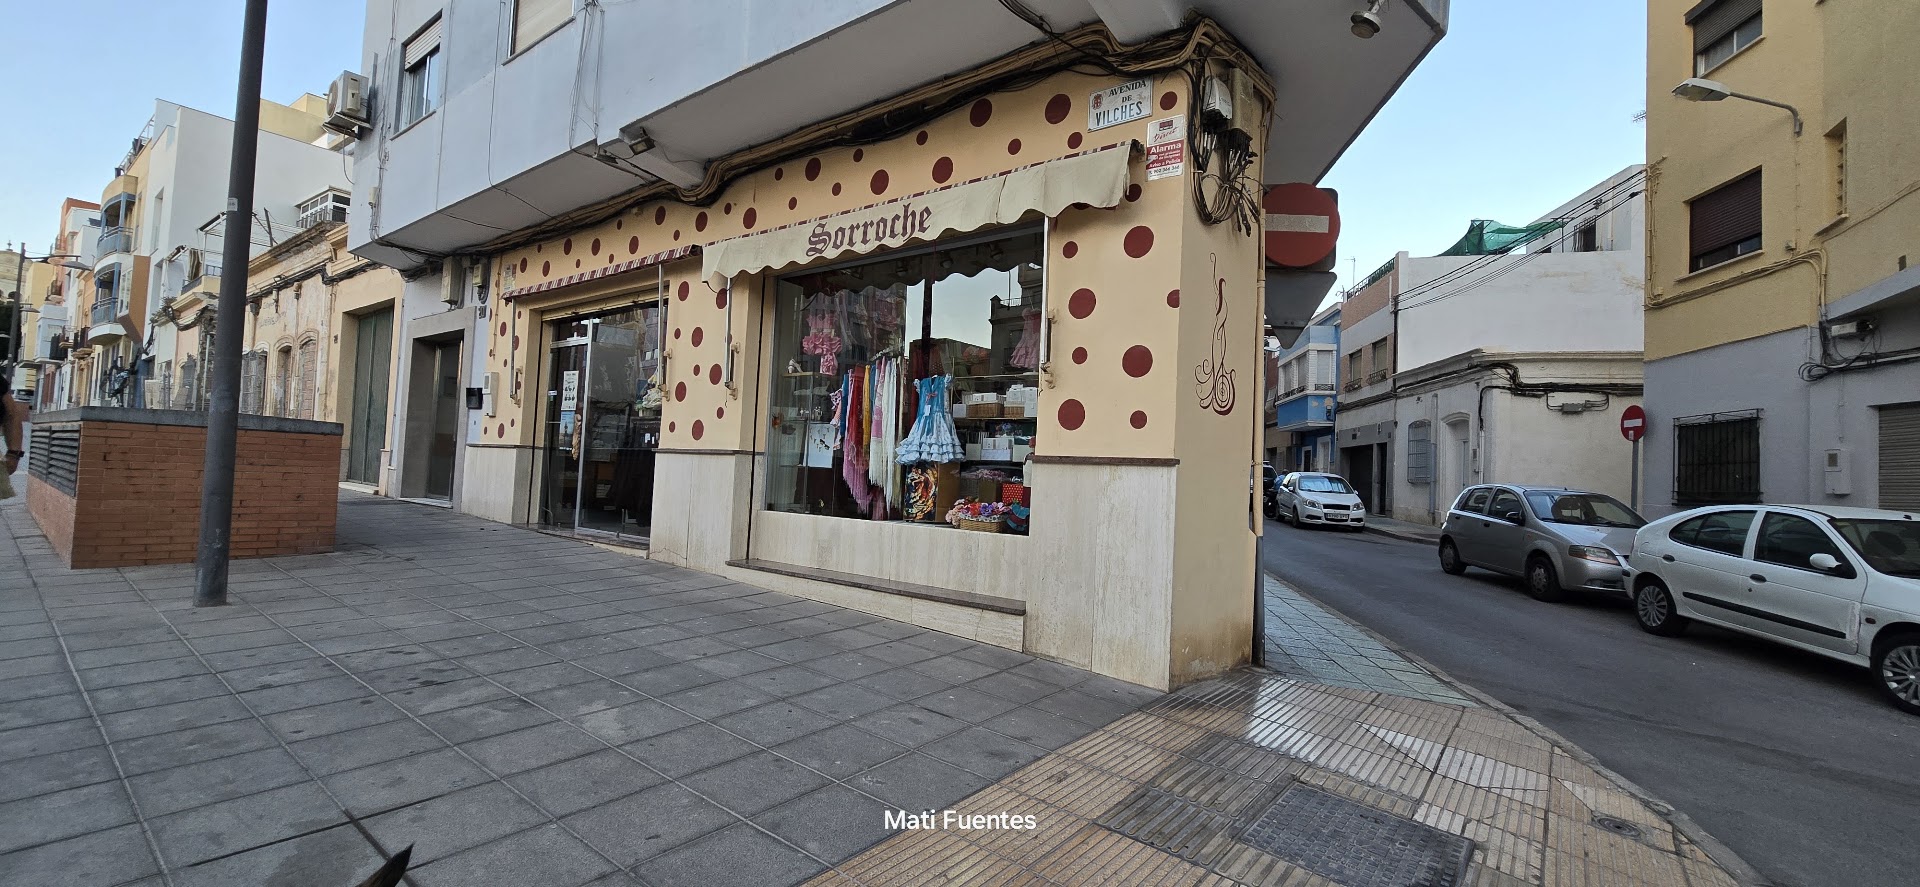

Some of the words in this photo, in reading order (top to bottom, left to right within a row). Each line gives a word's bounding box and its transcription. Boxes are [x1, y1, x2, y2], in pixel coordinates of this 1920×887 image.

[1108, 80, 1146, 97] AVENIDA
[1121, 95, 1132, 103] DE
[1096, 101, 1142, 126] VILCHES
[1150, 143, 1181, 154] Alarma
[806, 202, 932, 257] Sorroche
